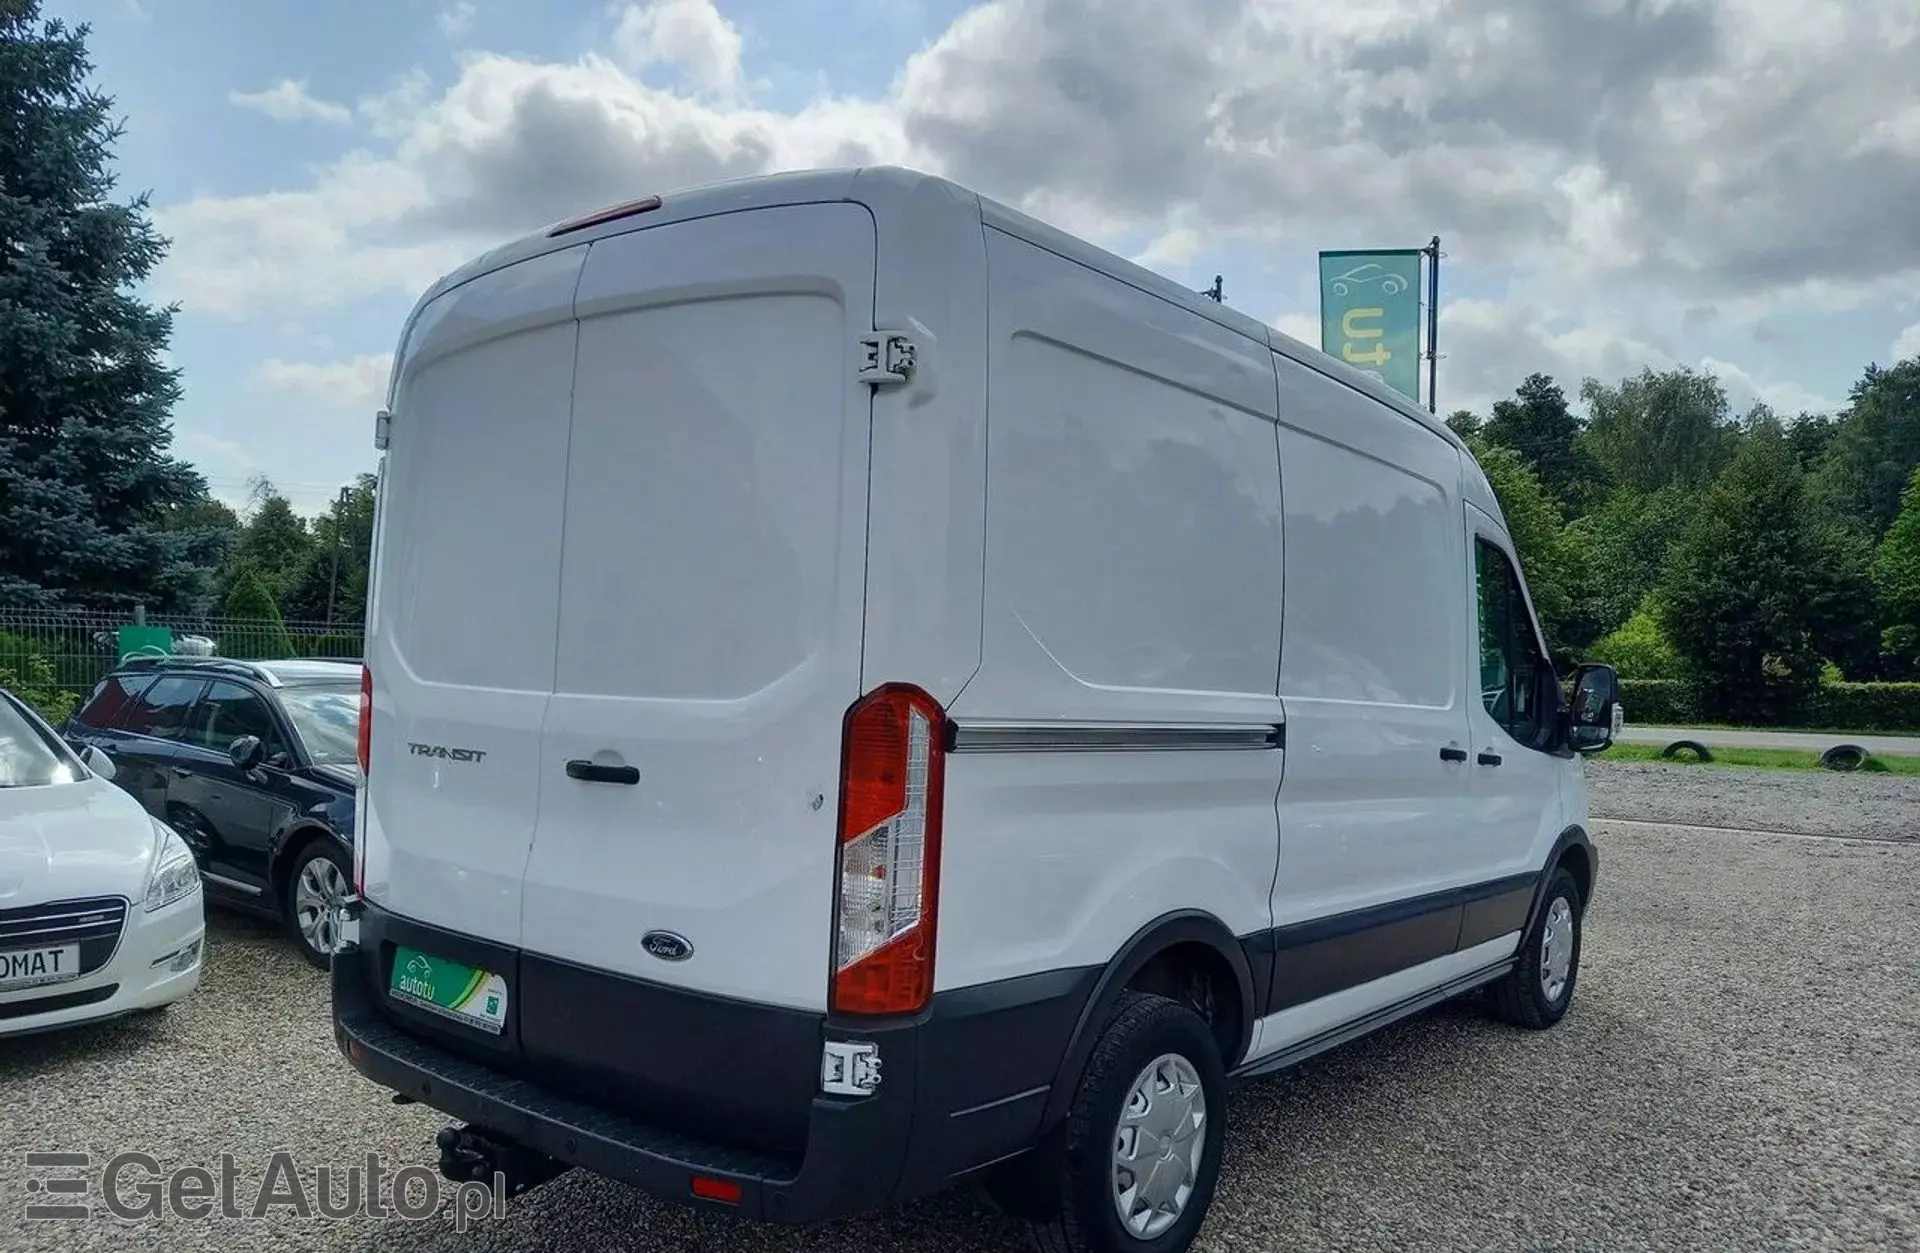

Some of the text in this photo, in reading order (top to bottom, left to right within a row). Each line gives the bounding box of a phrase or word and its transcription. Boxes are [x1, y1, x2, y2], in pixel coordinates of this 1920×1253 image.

[407, 742, 487, 763] TRANSIT
[649, 936, 678, 956] Ford
[399, 974, 436, 1001] autotu
